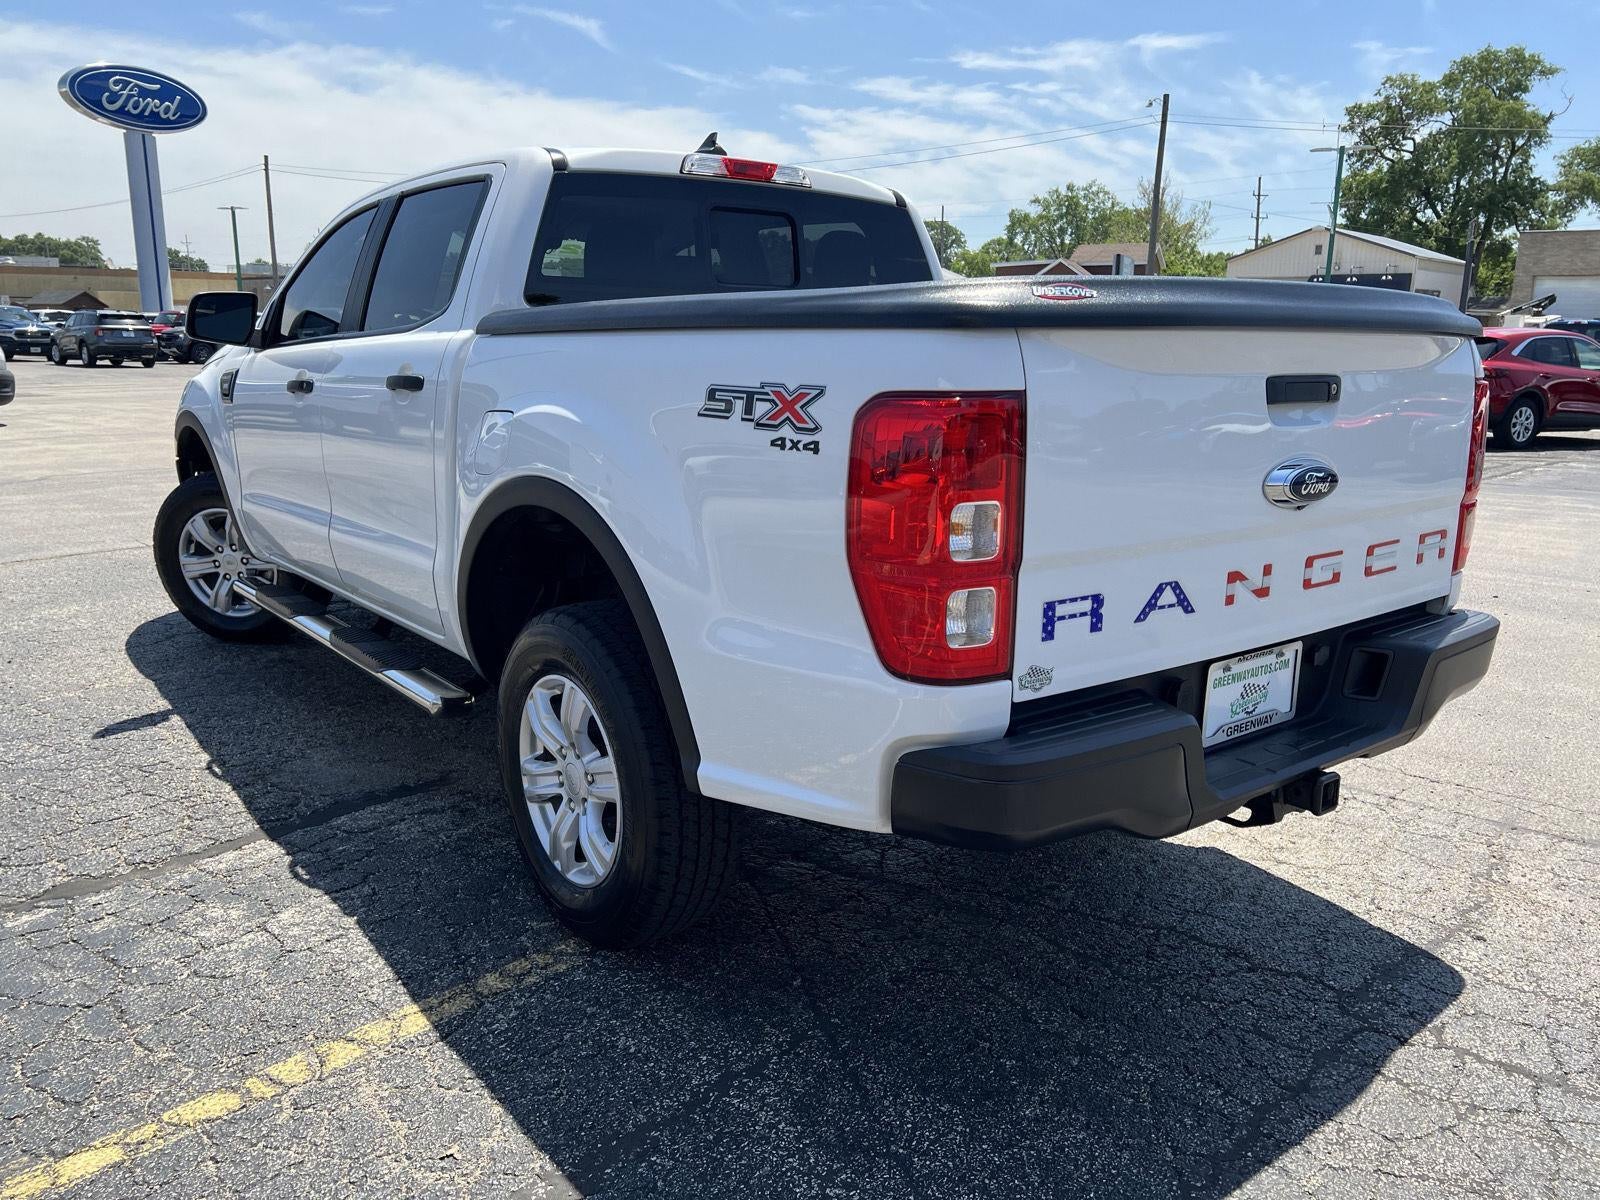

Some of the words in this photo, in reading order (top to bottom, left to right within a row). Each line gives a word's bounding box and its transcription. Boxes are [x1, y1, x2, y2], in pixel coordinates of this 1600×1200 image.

[102, 76, 181, 120] Ford
[697, 382, 826, 435] STX
[1302, 472, 1330, 495] Ford
[1041, 528, 1448, 642] RANGER
[1237, 649, 1274, 663] MORRIS
[1212, 658, 1290, 690] GREENWAYAUTOS.COM
[1226, 714, 1274, 737] GREENWAY
